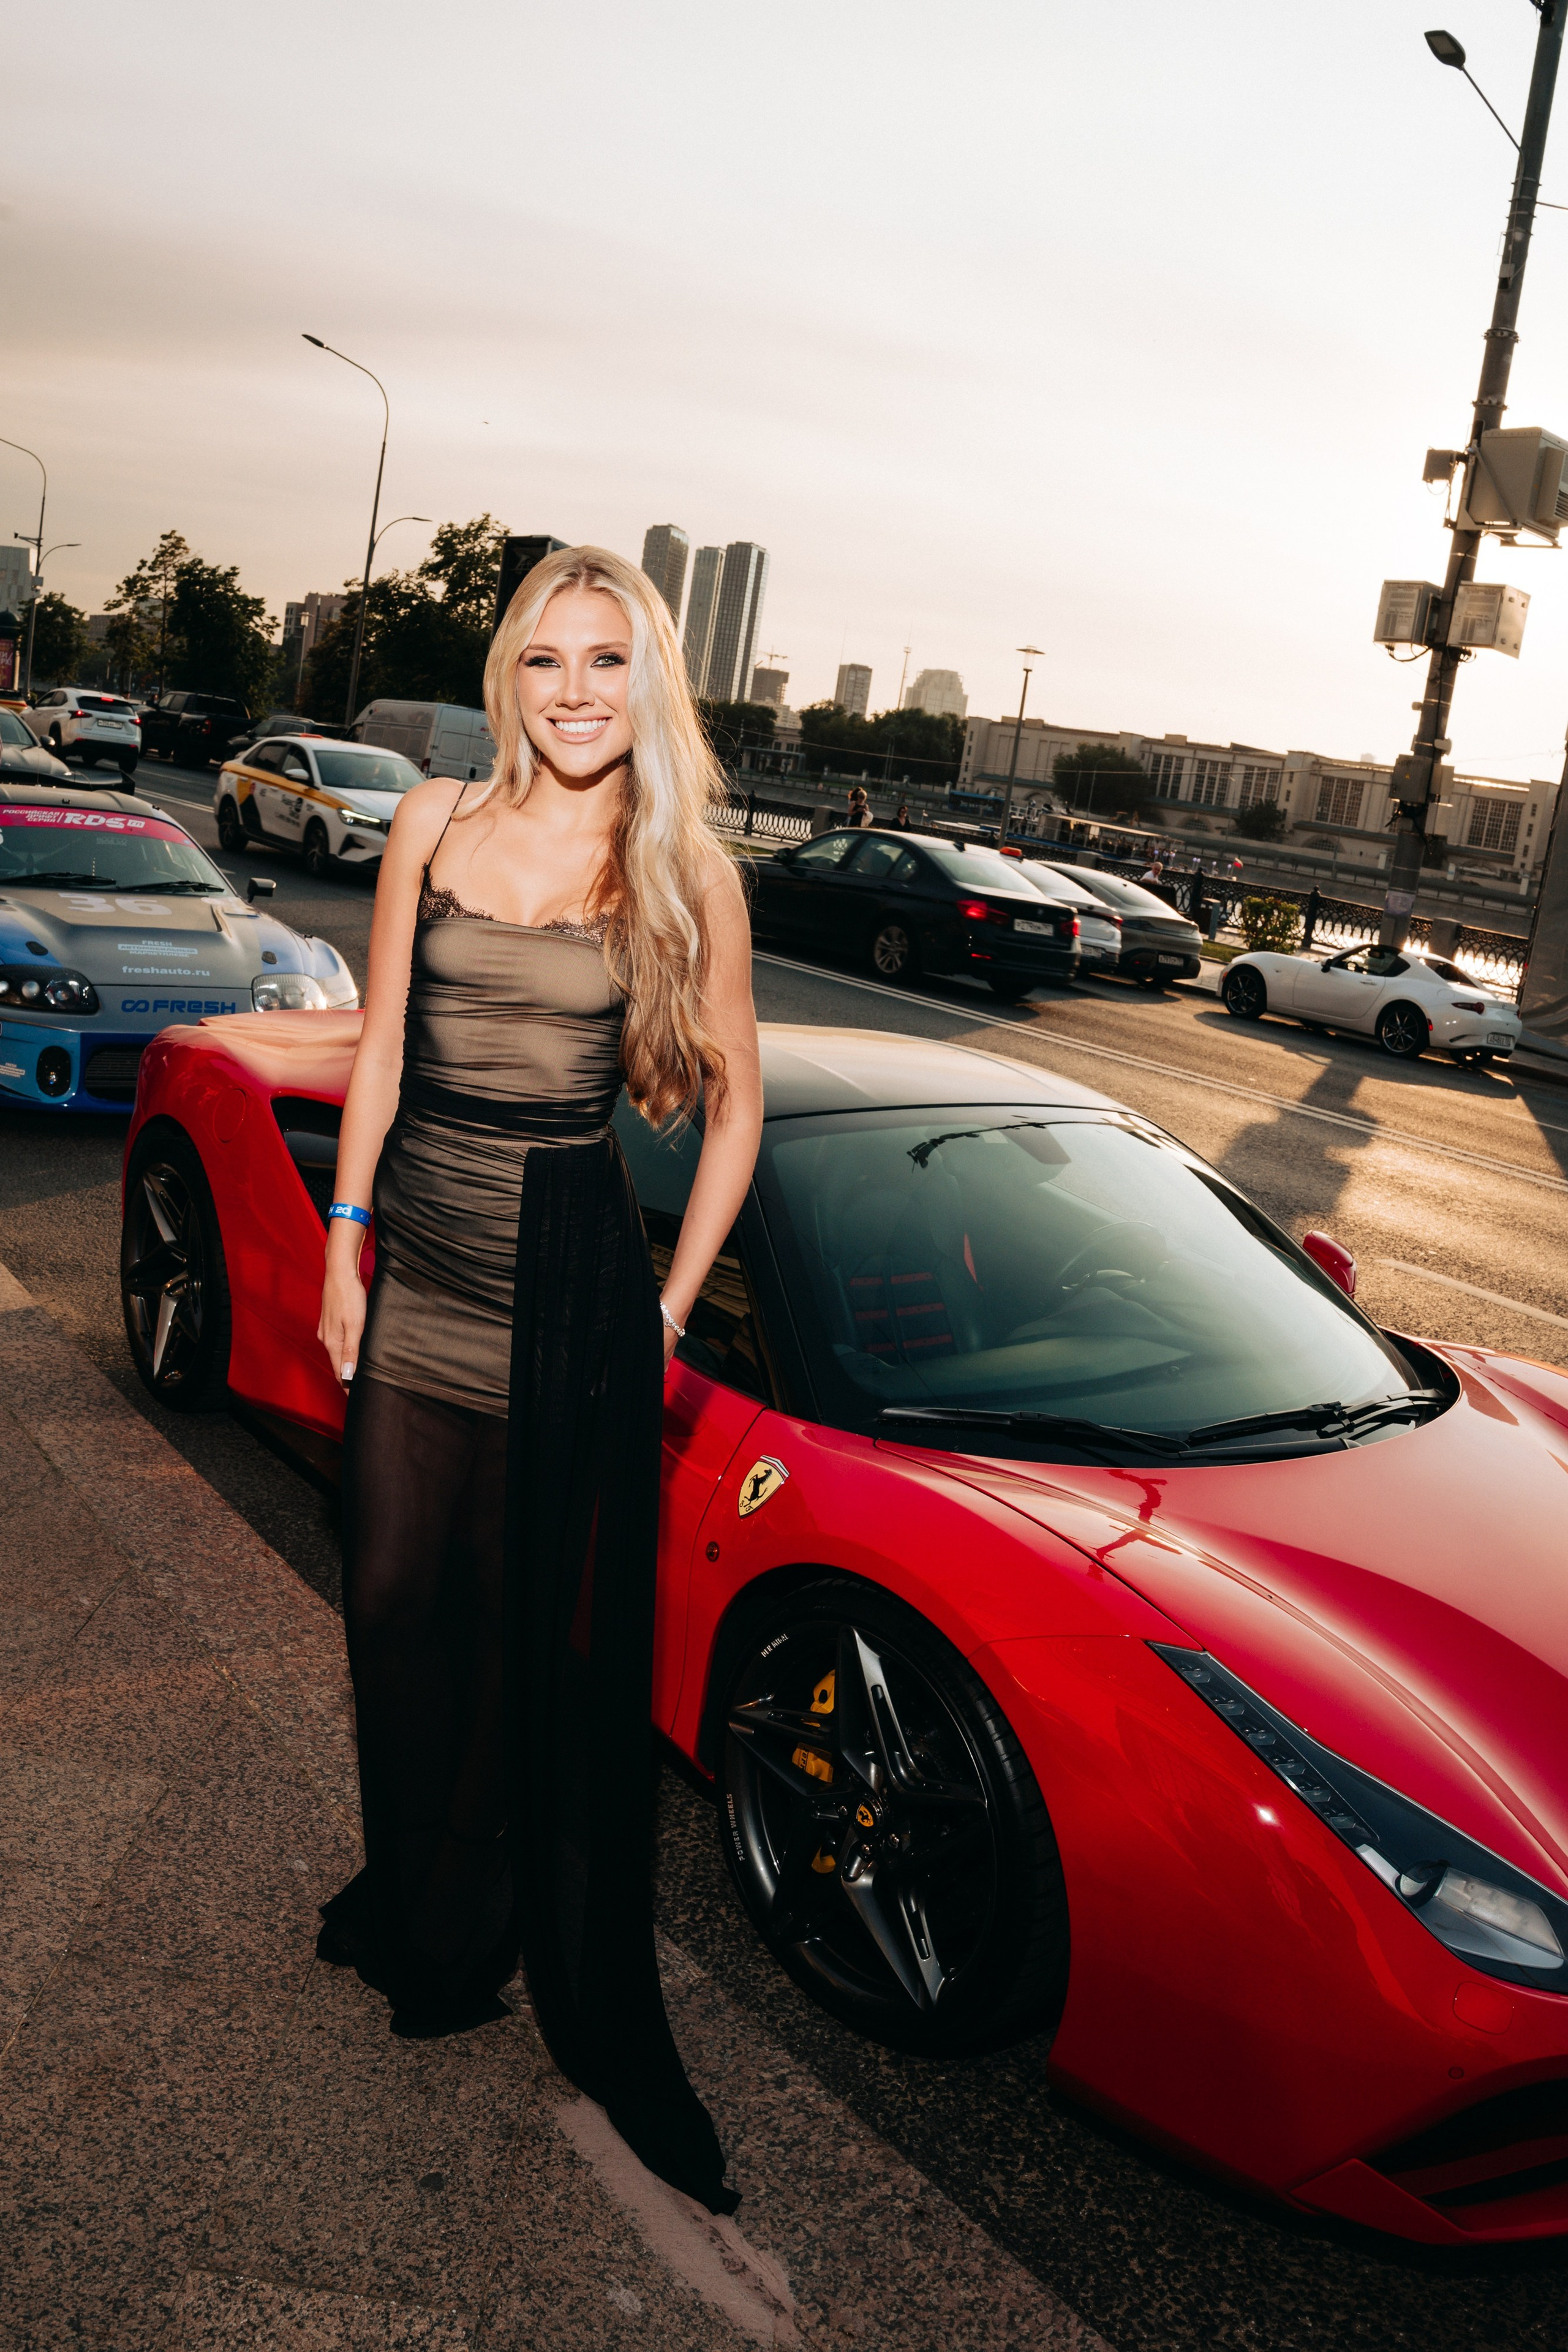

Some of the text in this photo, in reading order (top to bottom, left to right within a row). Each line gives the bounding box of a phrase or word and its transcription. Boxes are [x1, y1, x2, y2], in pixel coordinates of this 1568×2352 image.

[64, 813, 126, 829] RDS
[58, 892, 173, 915] 36
[122, 966, 210, 976] freshauto.ru
[726, 1793, 745, 1861] POWER WHEELS
